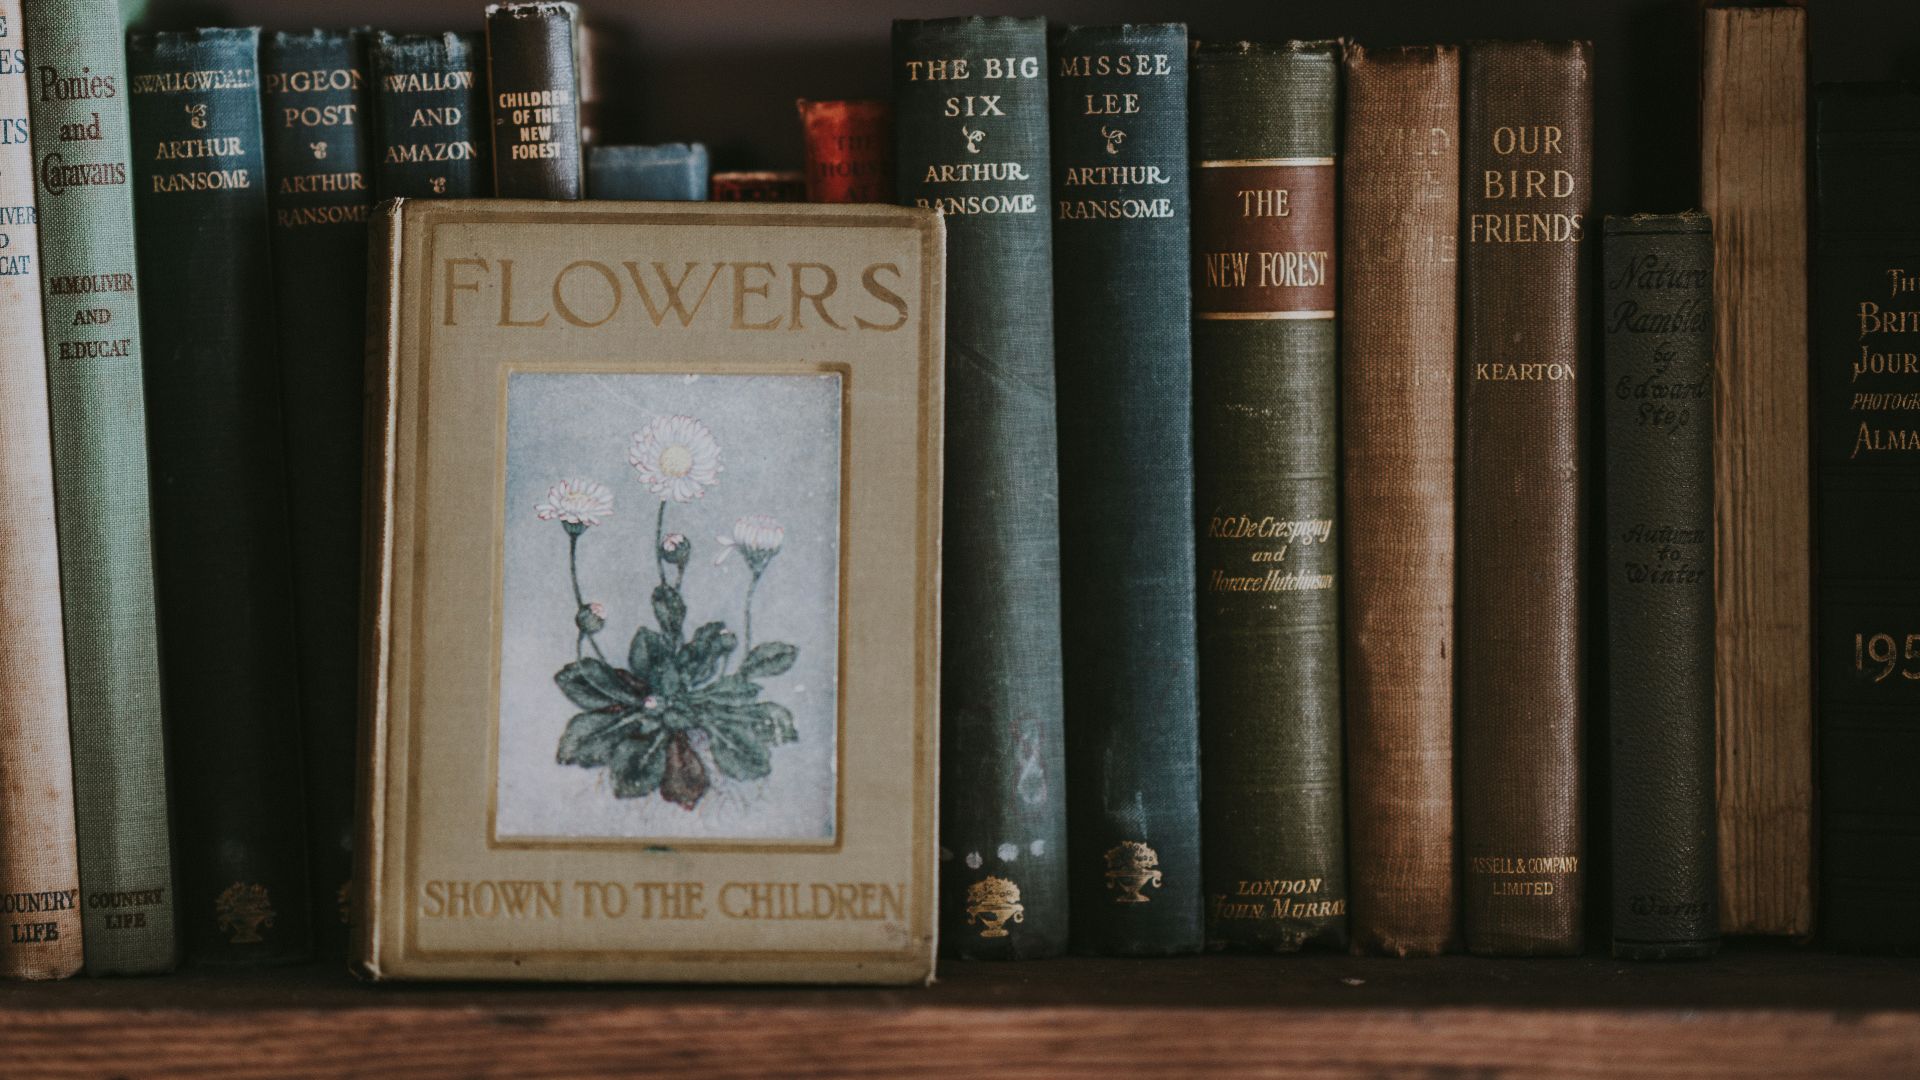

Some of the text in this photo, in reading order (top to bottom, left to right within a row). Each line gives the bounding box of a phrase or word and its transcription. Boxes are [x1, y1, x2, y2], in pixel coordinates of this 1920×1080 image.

[906, 57, 1039, 81] THE BIG
[1060, 54, 1172, 77] MISSEE
[40, 67, 116, 102] Ponies
[499, 90, 569, 109] CHILDREN
[944, 95, 1006, 117] SIX
[1085, 94, 1140, 115] LEE
[60, 112, 102, 141] and
[283, 104, 357, 128] POST
[410, 106, 462, 128] AND
[513, 107, 562, 125] OF THE
[520, 125, 551, 142] NEW
[1493, 126, 1563, 155] OUR
[155, 136, 245, 161] ARTHUR
[384, 141, 478, 164] AMAZON
[511, 142, 561, 160] FOREST
[41, 152, 126, 196] Caravans
[152, 169, 250, 193] RANSOME
[280, 172, 369, 194] ARTHUR
[923, 162, 1029, 182] ARTHUR
[1065, 166, 1170, 186] ARTHUR
[1484, 169, 1575, 198] BIRD
[1058, 198, 1174, 220] RANSOME
[1238, 189, 1291, 217] THE
[277, 204, 369, 228] RANSOME
[1469, 213, 1585, 243] FRIENDS
[1205, 251, 1328, 288] NEW FOREST
[1608, 254, 1708, 290] Nature
[443, 257, 908, 332] FLOWERS
[72, 308, 112, 326] AND
[1607, 300, 1709, 334] Rambles
[1653, 341, 1677, 373] by
[1476, 363, 1577, 382] KEARTON
[1251, 544, 1288, 562] and
[1657, 543, 1681, 561] to
[1625, 562, 1706, 585] Winter
[1516, 857, 1527, 874] &
[1528, 856, 1579, 874] COMPANY
[1237, 878, 1322, 896] LONDON
[1493, 881, 1554, 896] LIMITED
[88, 888, 165, 911] COUNTRY
[421, 880, 906, 921] SHOWN TO THE CHILDREN
[105, 912, 147, 930] LIFE
[10, 921, 59, 945] LIFE
